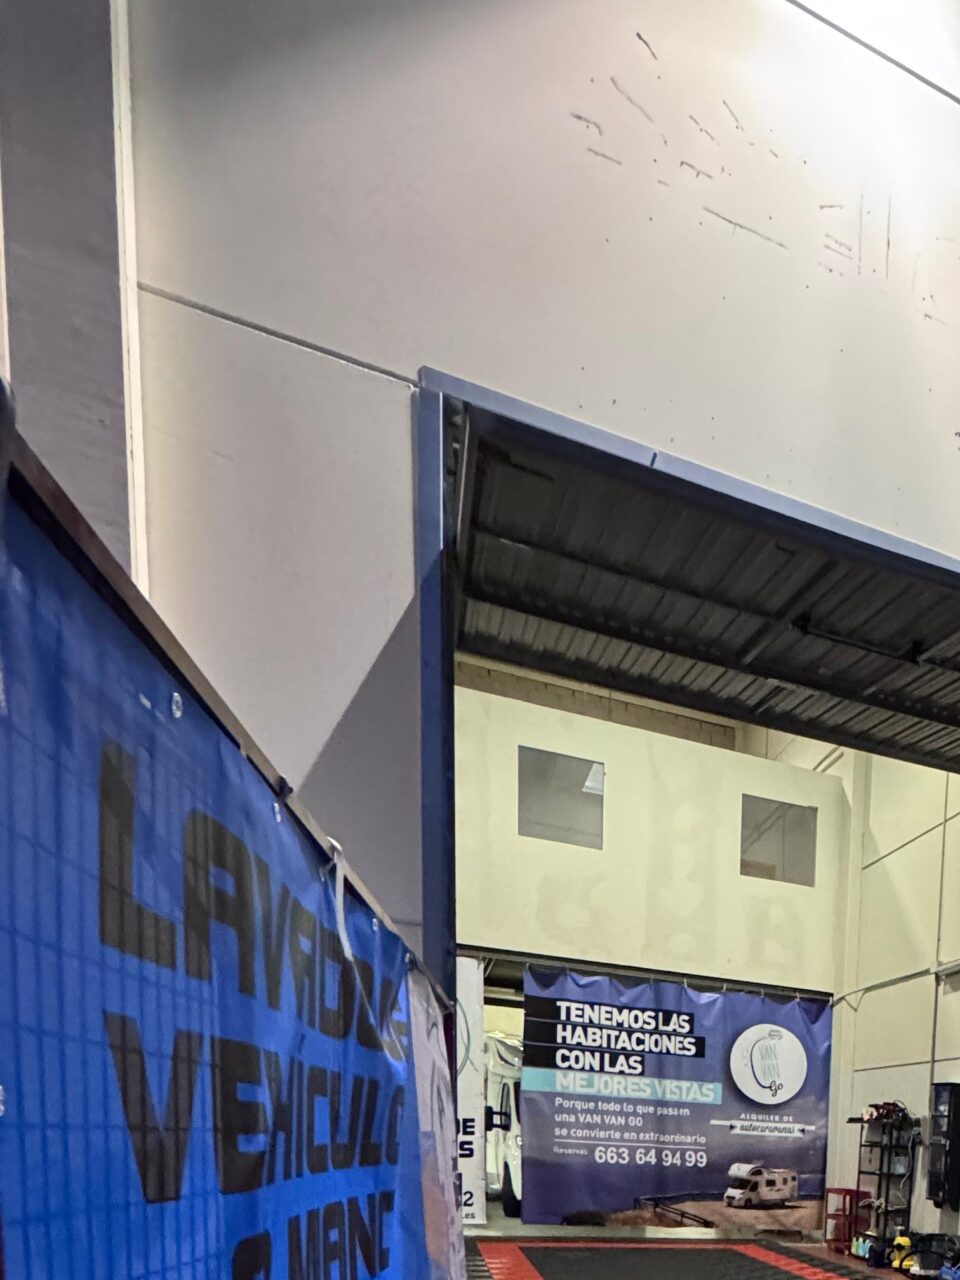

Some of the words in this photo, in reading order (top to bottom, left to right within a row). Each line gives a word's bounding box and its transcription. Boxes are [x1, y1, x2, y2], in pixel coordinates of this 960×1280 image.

[556, 1001, 656, 1030] TENEMOS
[658, 1011, 691, 1034] LAS
[556, 1023, 697, 1057] HABITACIONES
[555, 1048, 601, 1072] CON
[603, 1052, 643, 1075] LAS
[556, 1071, 652, 1098] MEJORES
[652, 1080, 715, 1102] VISTAS
[554, 1097, 595, 1111] Porque
[598, 1101, 621, 1112] todo
[623, 1102, 634, 1113] lo
[636, 1104, 655, 1116] que
[656, 1107, 678, 1117] pasa
[679, 1108, 690, 1117] en
[740, 1113, 780, 1122] ALQUILER
[554, 1114, 576, 1123] una
[578, 1113, 601, 1125] VAN
[603, 1115, 626, 1126] VAN
[628, 1116, 643, 1127] GO
[554, 1128, 568, 1137] se
[570, 1128, 621, 1140] convierte
[623, 1132, 637, 1141] en
[639, 1132, 706, 1144] extraordinario
[594, 1147, 630, 1165] 663
[635, 1149, 657, 1166] 64
[661, 1151, 681, 1168] 94
[685, 1151, 707, 1168] 99
